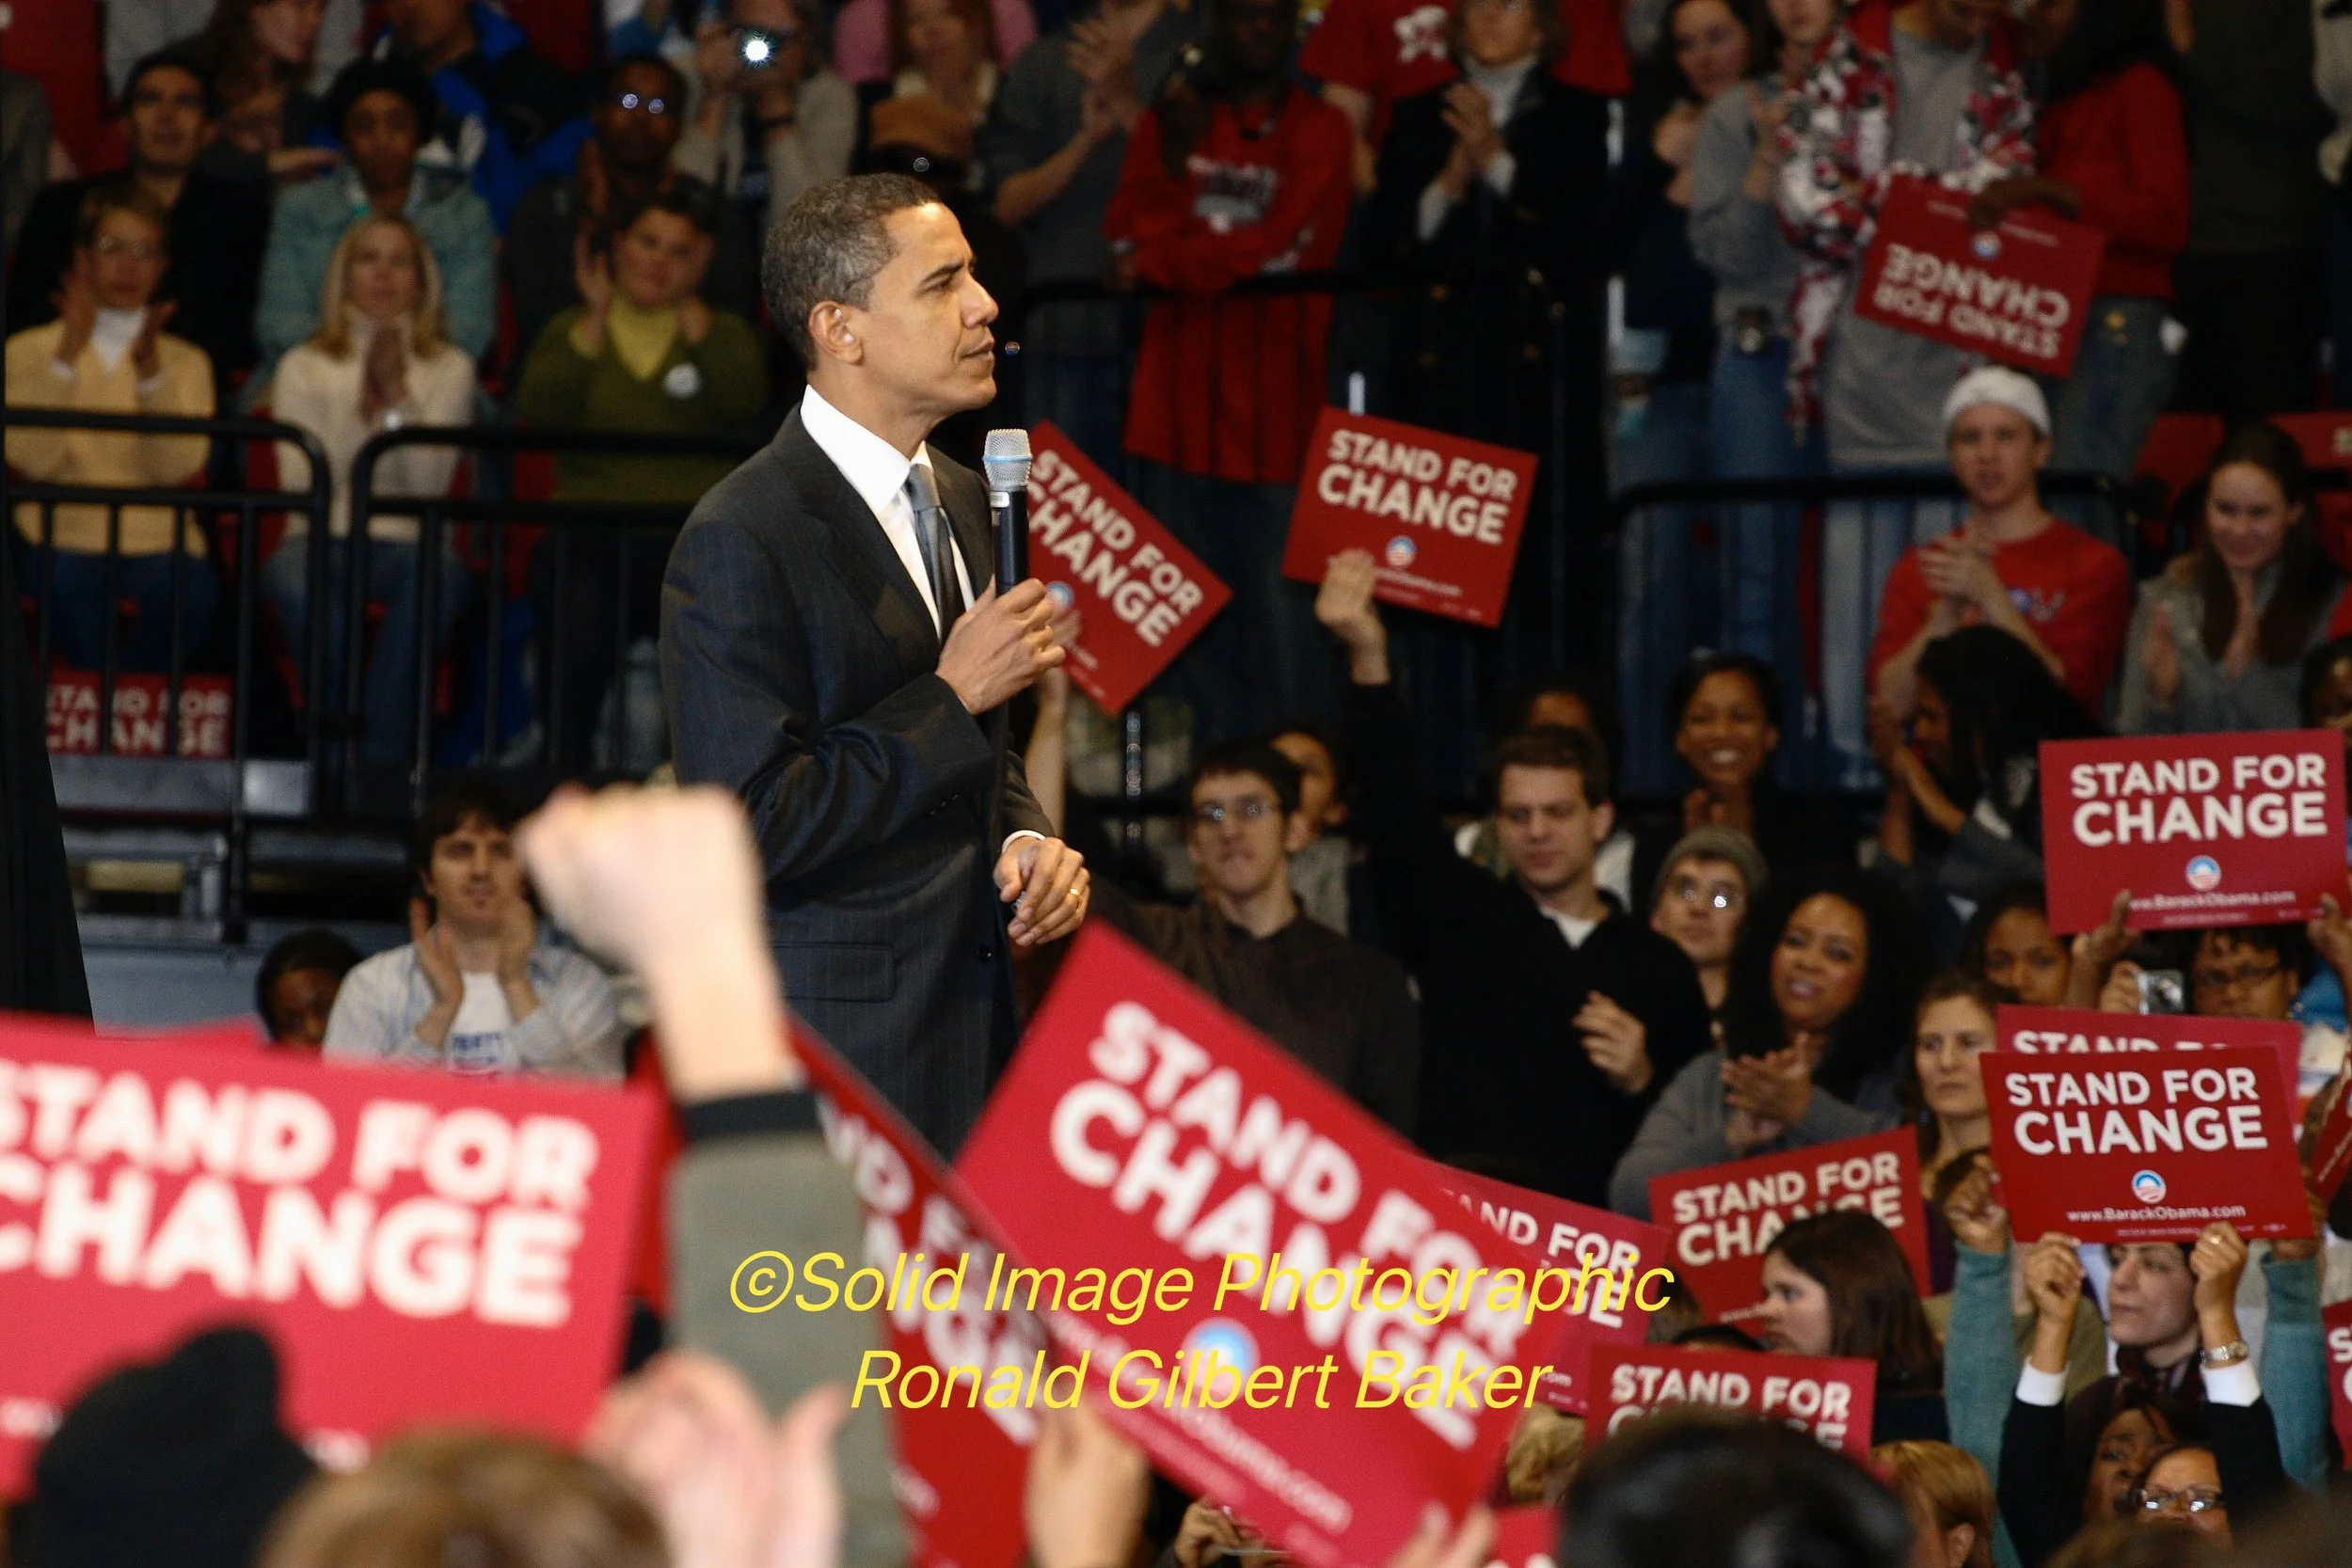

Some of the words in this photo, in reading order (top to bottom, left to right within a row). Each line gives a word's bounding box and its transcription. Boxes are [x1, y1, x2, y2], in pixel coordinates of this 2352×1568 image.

[1872, 282, 1946, 325] FOR
[1883, 243, 2070, 328] CHANGE
[1947, 303, 2062, 360] STAND
[1327, 429, 1443, 483] STAND
[1445, 456, 1518, 502] FOR
[1030, 449, 1136, 551] STAND
[1129, 542, 1204, 616] FOR
[1319, 462, 1509, 546] CHANGE
[1027, 480, 1183, 648] HANGE
[2071, 757, 2220, 800] STAND
[2233, 752, 2327, 791] FOR
[2073, 791, 2328, 847] CHANGE
[2005, 1070, 2152, 1107] STAND
[2163, 1067, 2260, 1104] FOR
[352, 1099, 599, 1213] FOR
[2013, 1105, 2268, 1156] CHANGE
[1089, 1000, 1362, 1224] STAND
[1360, 1190, 1532, 1360] FOR
[1671, 1171, 1807, 1224] STAND
[1817, 1151, 1900, 1196] FOR
[2066, 1204, 2247, 1223] www.BarackObama.com
[1546, 1222, 1641, 1277] FOR
[1677, 1186, 1905, 1266] CHAE
[1050, 1079, 1503, 1450] CHANGE
[1611, 1363, 1752, 1407] STAND
[1762, 1376, 1852, 1419] FOR
